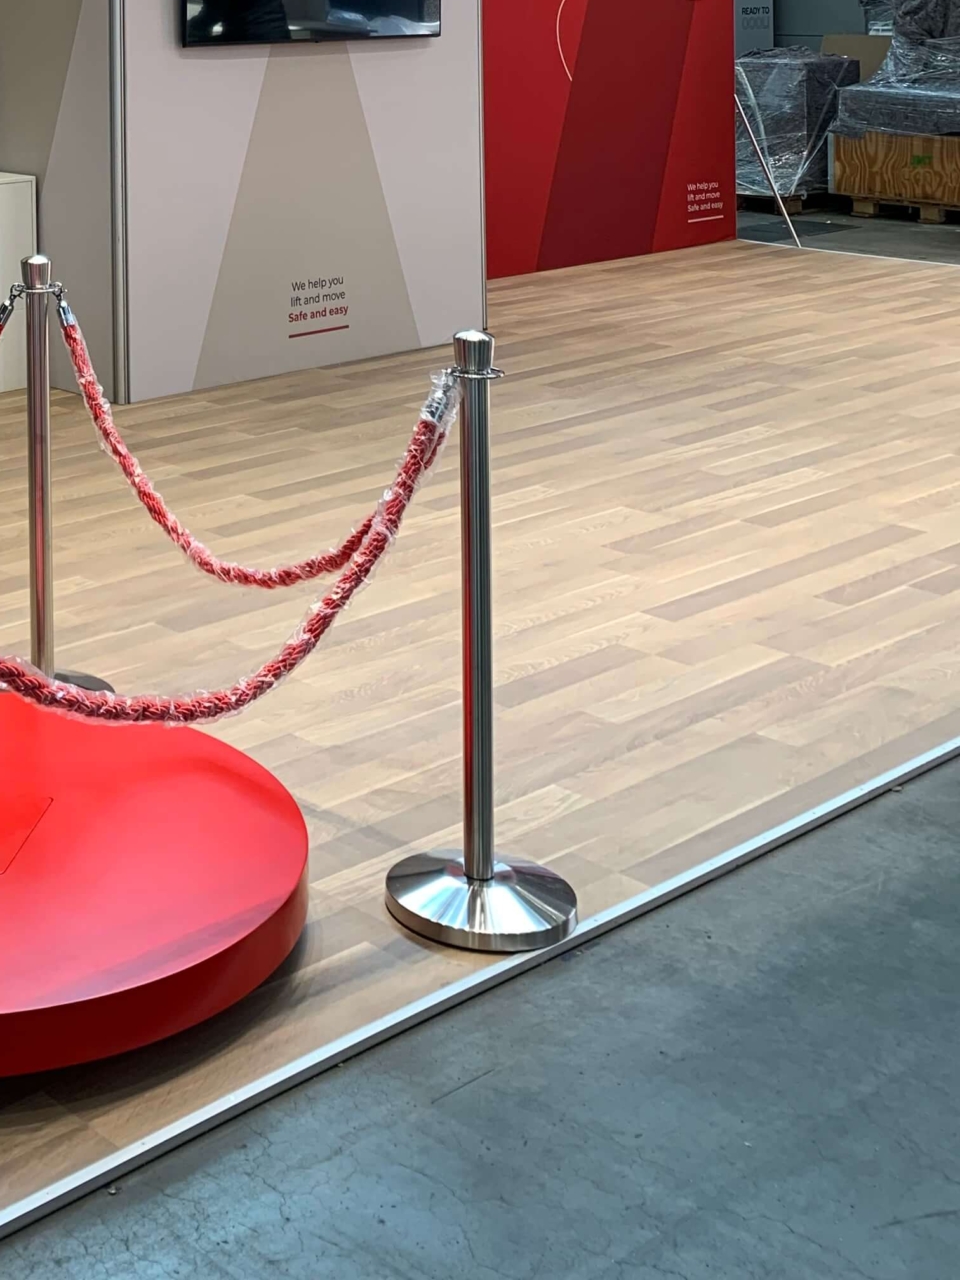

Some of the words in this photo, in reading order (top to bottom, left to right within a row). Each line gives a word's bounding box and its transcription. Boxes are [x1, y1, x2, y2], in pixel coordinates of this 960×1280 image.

[742, 7, 760, 15] READY
[761, 6, 770, 15] TO
[687, 183, 696, 191] We
[697, 181, 708, 190] help
[709, 182, 719, 190] you
[695, 192, 705, 201] and
[706, 191, 721, 199] move
[687, 203, 699, 212] Safe
[700, 202, 710, 210] and
[291, 281, 306, 291] We
[308, 277, 327, 289] help
[328, 276, 344, 289] you
[290, 296, 302, 307] lift
[303, 293, 320, 306] and
[322, 291, 346, 302] move
[288, 310, 308, 323] Safe
[310, 306, 327, 320] and
[329, 305, 349, 316] easy
